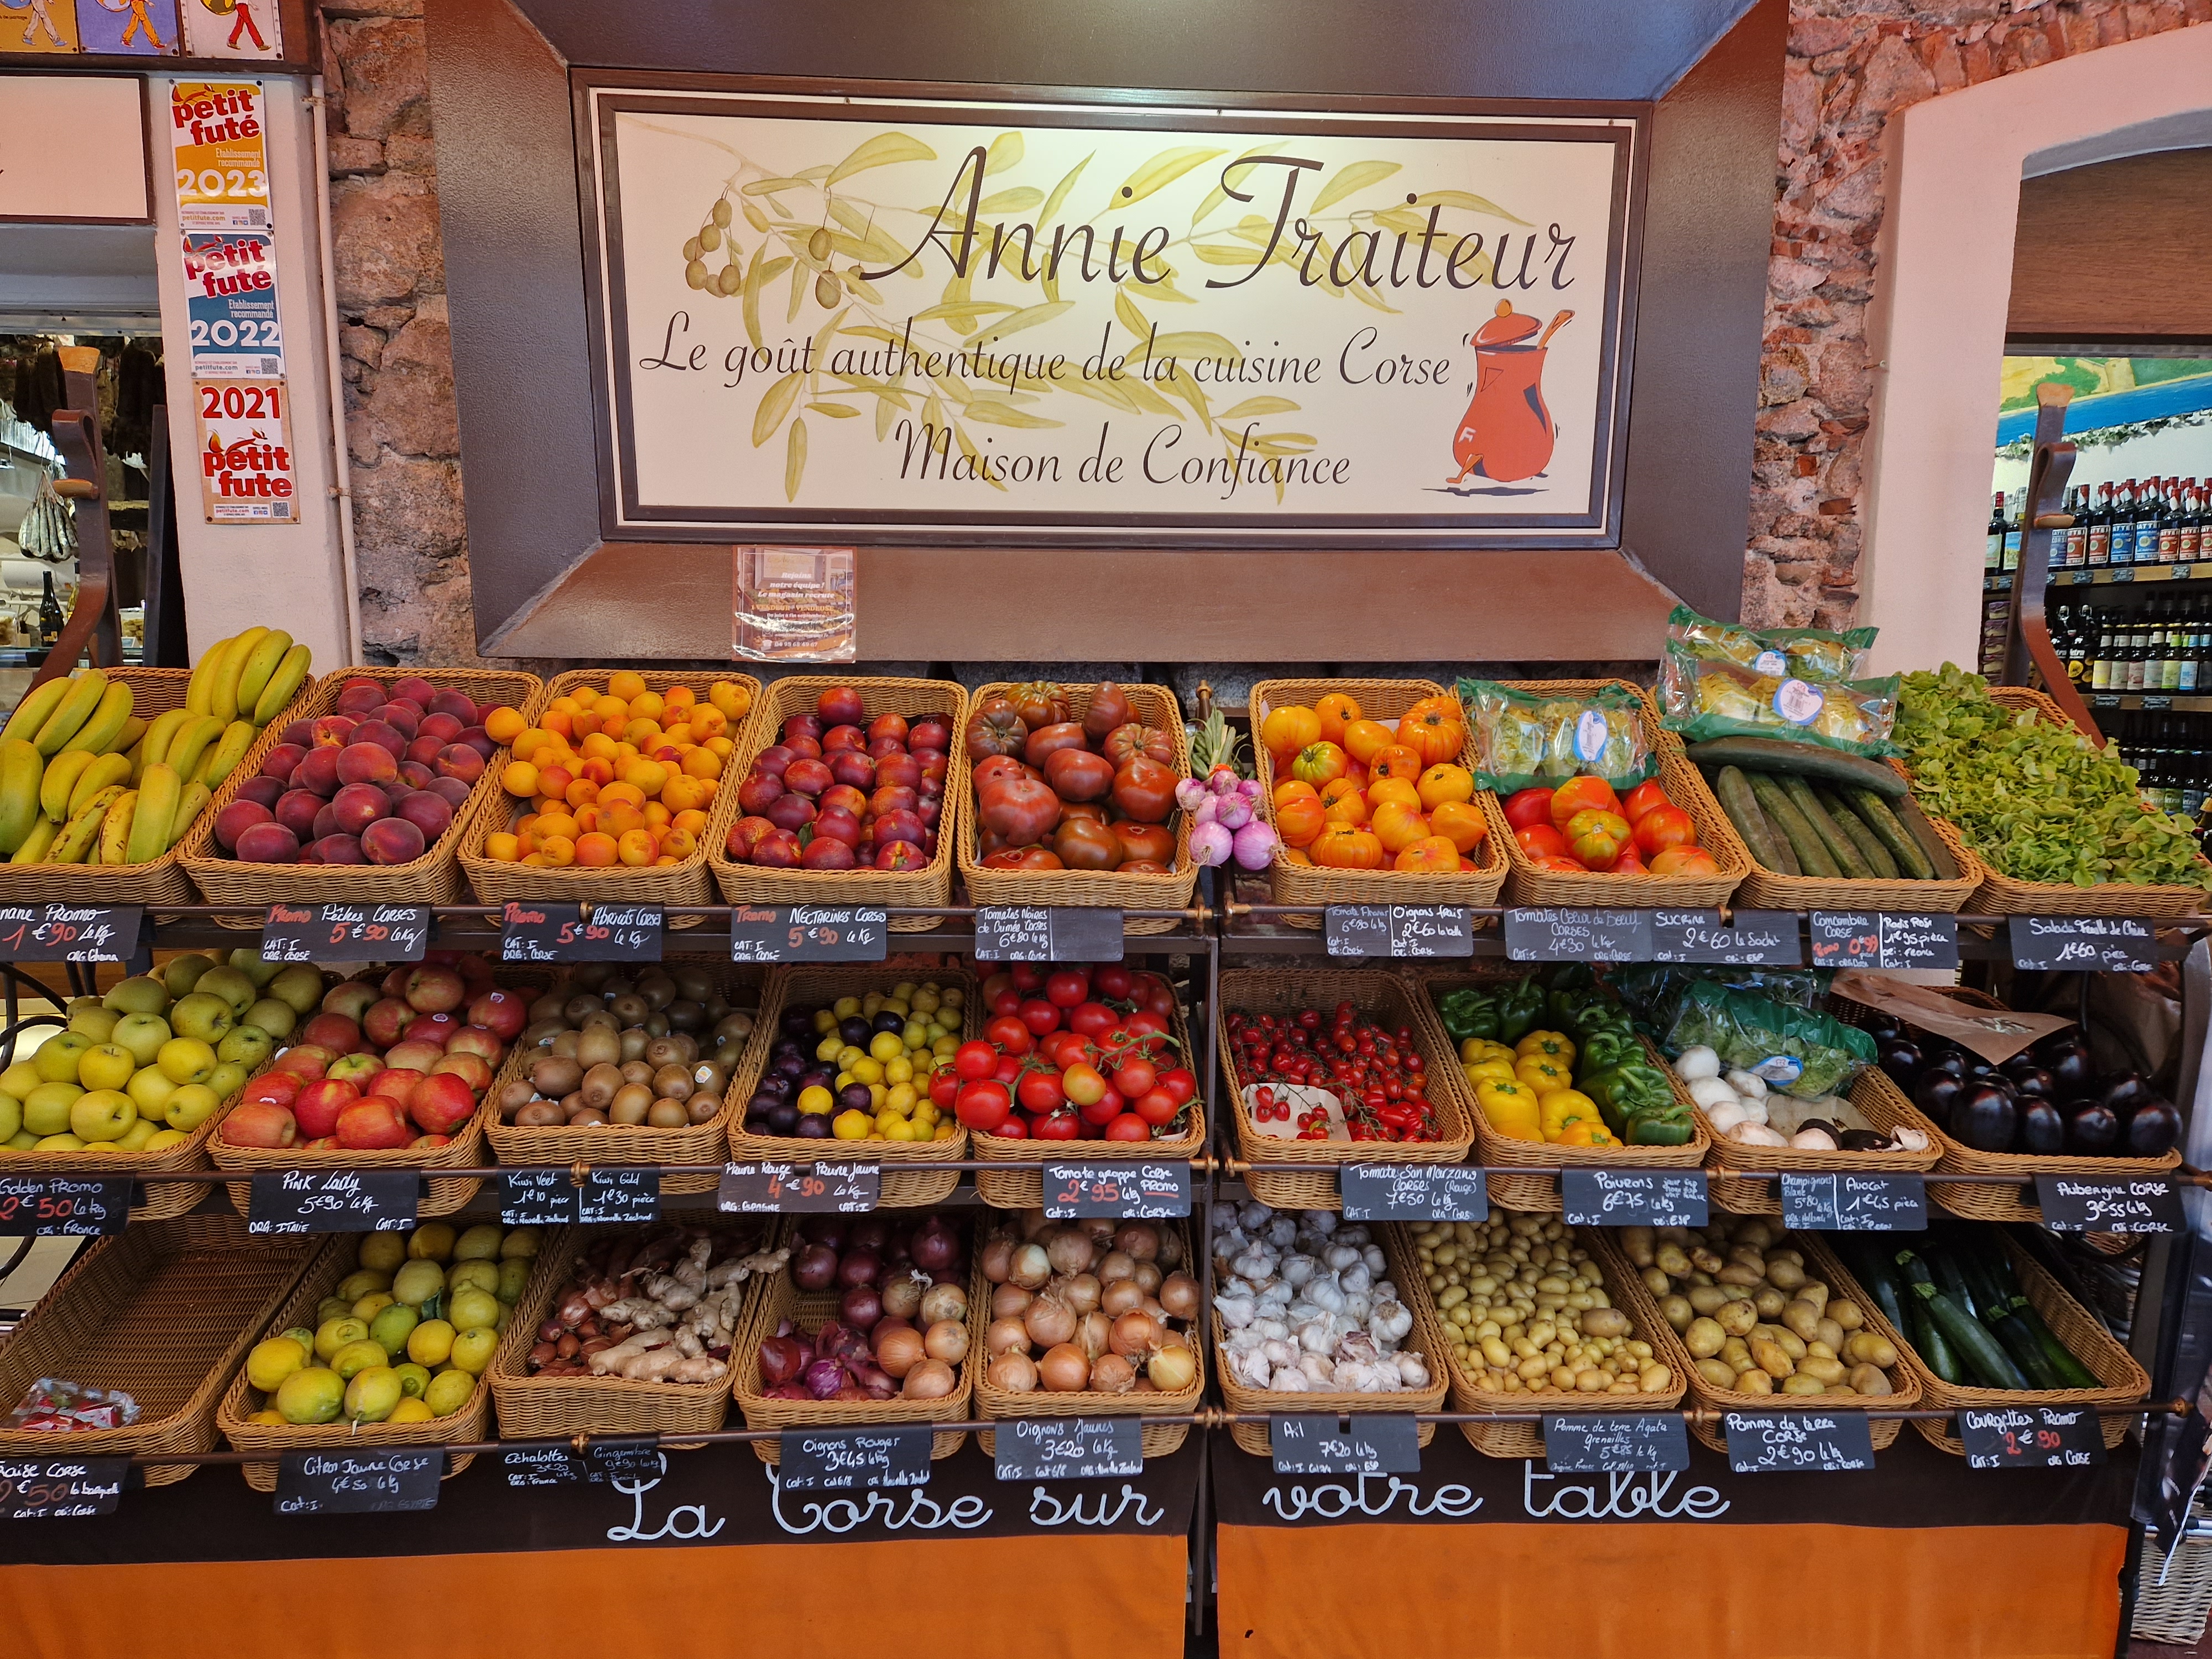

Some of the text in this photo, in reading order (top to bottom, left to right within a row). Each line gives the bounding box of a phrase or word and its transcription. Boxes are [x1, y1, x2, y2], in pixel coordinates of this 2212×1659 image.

[172, 89, 254, 128] petit
[190, 114, 260, 146] futé
[216, 148, 261, 158] Etablissement
[218, 159, 260, 167] recommandé
[177, 169, 267, 197] 2023
[859, 145, 1578, 291] Annie Traiteur
[184, 239, 265, 280] petit
[202, 265, 272, 297] futé
[228, 299, 274, 310] Etablissement
[231, 310, 273, 319] recommandé
[191, 320, 280, 347] 2022
[639, 311, 1452, 395] Le goût authentique de la cuisine Corse
[201, 387, 280, 419] 2021
[203, 444, 290, 477] petit
[895, 419, 1352, 500] Maison de Confiance
[218, 471, 293, 497] fute
[1509, 907, 1558, 923] Tomates
[1551, 922, 1590, 936] CORSES
[1048, 1166, 1095, 1180] Tomate
[1553, 1417, 1668, 1438] Pomme de terre Agata
[1726, 1412, 1775, 1432] Pomme
[1779, 1415, 1798, 1431] de
[802, 1438, 847, 1458] Oignons
[607, 1450, 726, 1542] La
[1030, 1485, 1165, 1527] sur
[1262, 1459, 1732, 1522] votre table
